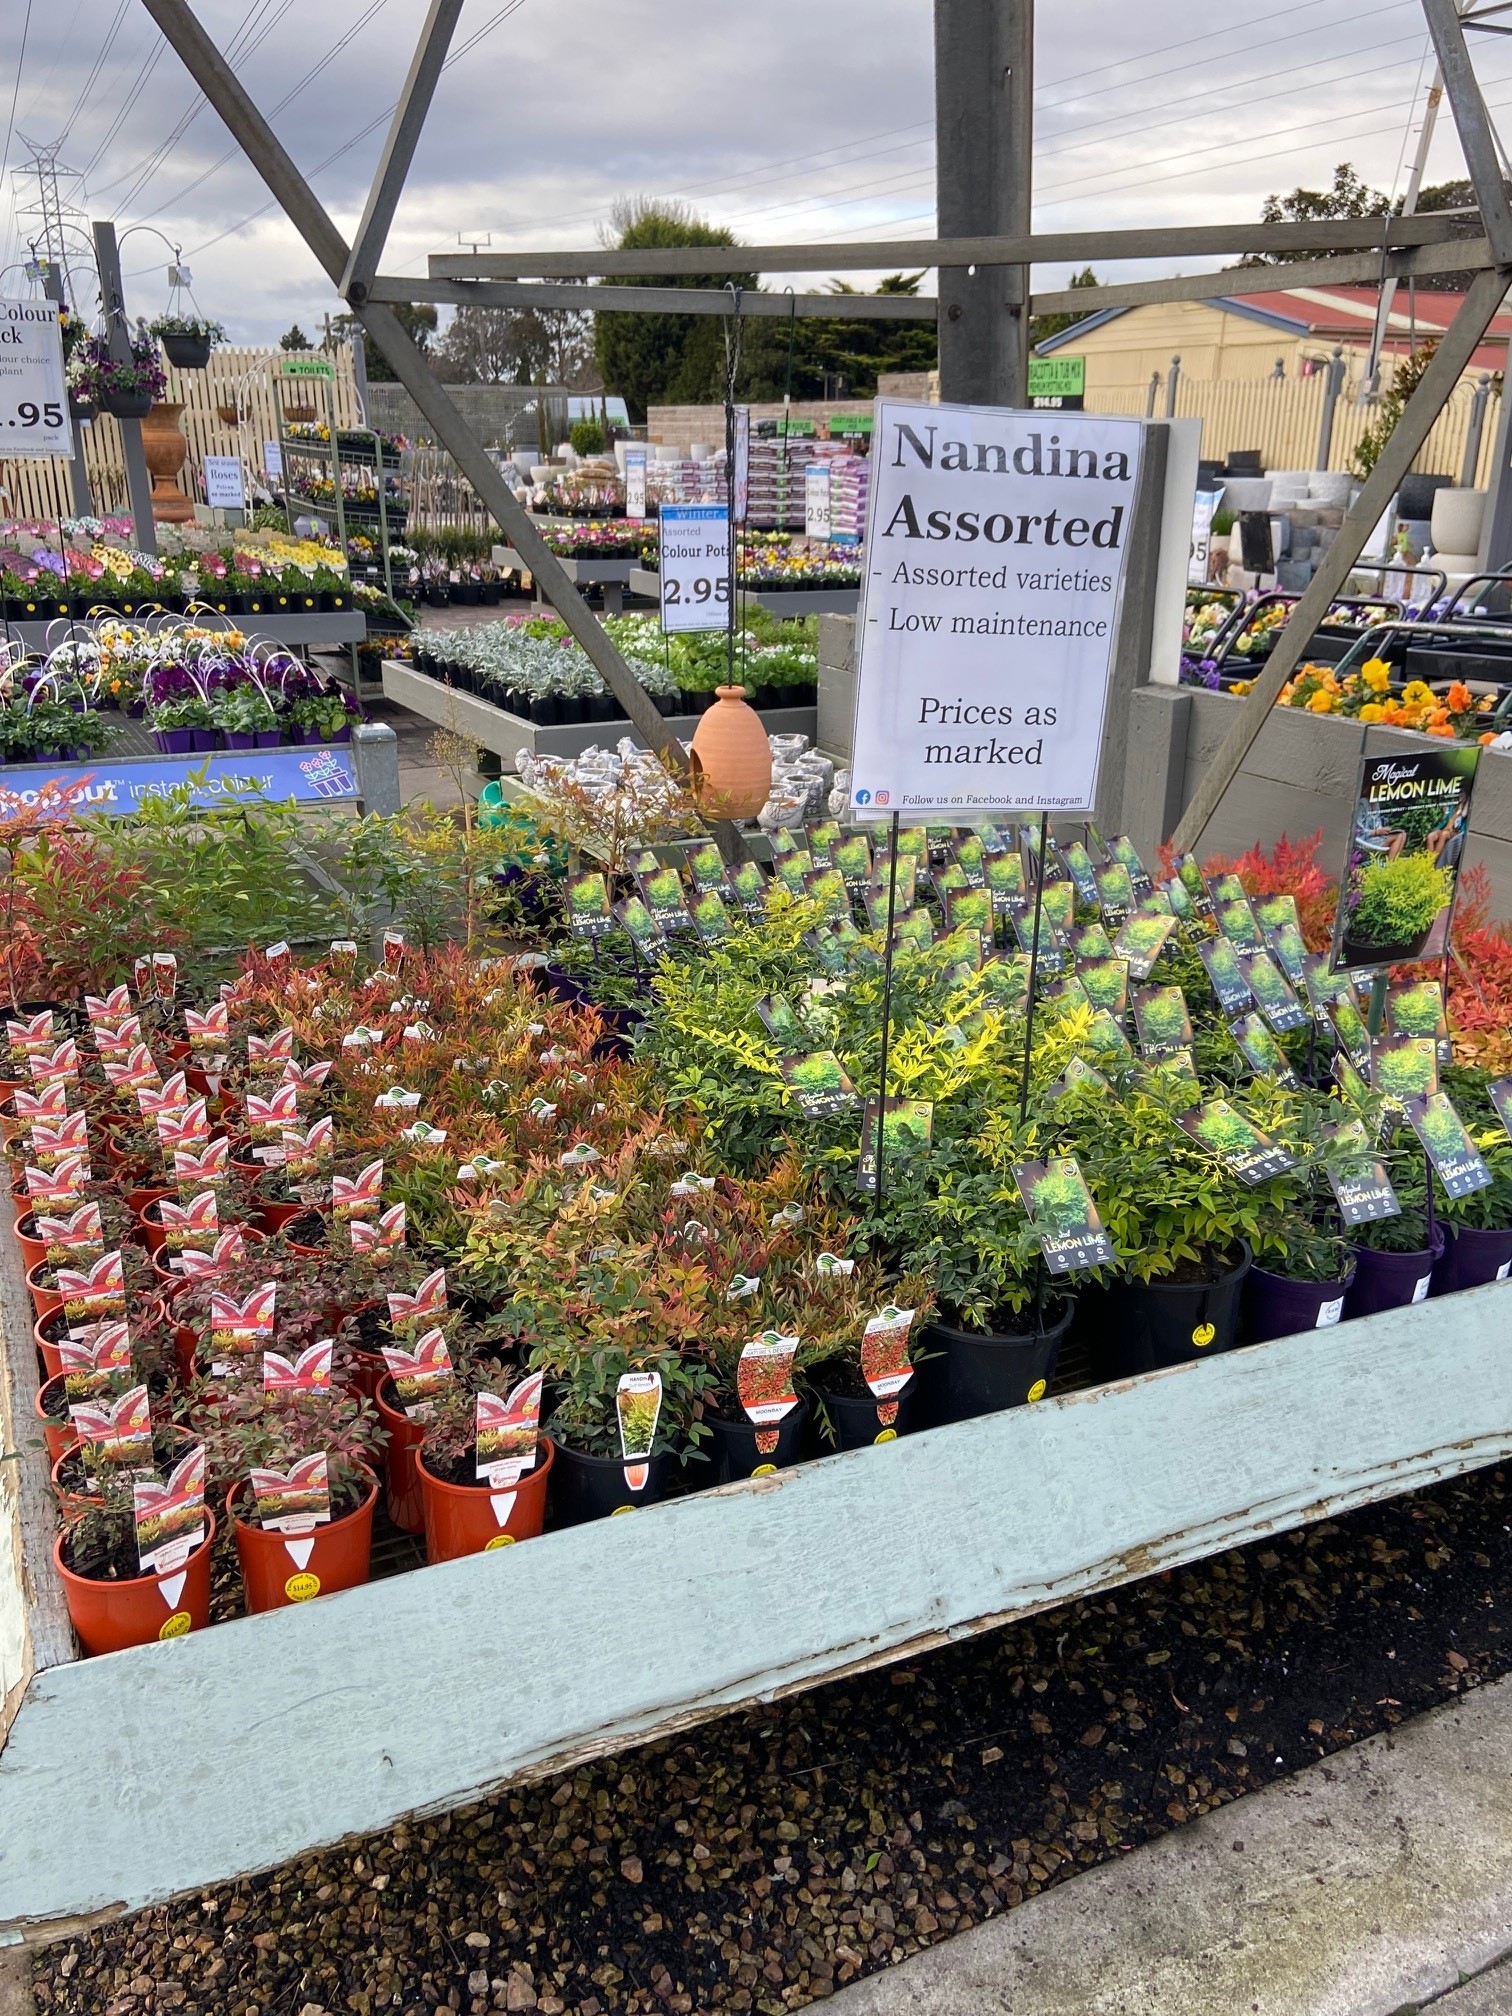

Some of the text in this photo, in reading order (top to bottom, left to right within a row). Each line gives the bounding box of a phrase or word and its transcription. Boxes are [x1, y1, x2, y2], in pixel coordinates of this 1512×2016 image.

[0, 303, 56, 323] Colour
[0, 326, 23, 344] ck
[21, 355, 50, 365] choice
[0, 402, 64, 428] .95
[890, 421, 1133, 482] Nandina
[210, 469, 239, 480] Roses
[807, 508, 830, 522] 2.95
[881, 494, 1126, 550] Assorted
[663, 526, 701, 536] Assorted
[661, 544, 702, 558] Colour
[891, 560, 1008, 590] Assorted
[1016, 567, 1113, 593] varieties
[664, 577, 730, 605] 2.95
[888, 607, 943, 634] Low
[950, 611, 1108, 638] maintenance
[917, 696, 1058, 727] Prices as
[923, 737, 1044, 766] marked
[1371, 762, 1420, 786] Magical
[1369, 776, 1465, 803] LEMON LIME
[902, 794, 1083, 807] Follow us on Facebook and Instagram
[800, 1095, 835, 1108] LEMON
[1441, 1158, 1484, 1181] LEMON LIME
[1340, 1186, 1391, 1206] LEMON LIME
[1045, 1232, 1106, 1254] LEMON LIME
[755, 1407, 783, 1415] MOONBAY
[293, 1583, 313, 1592] $14.95
